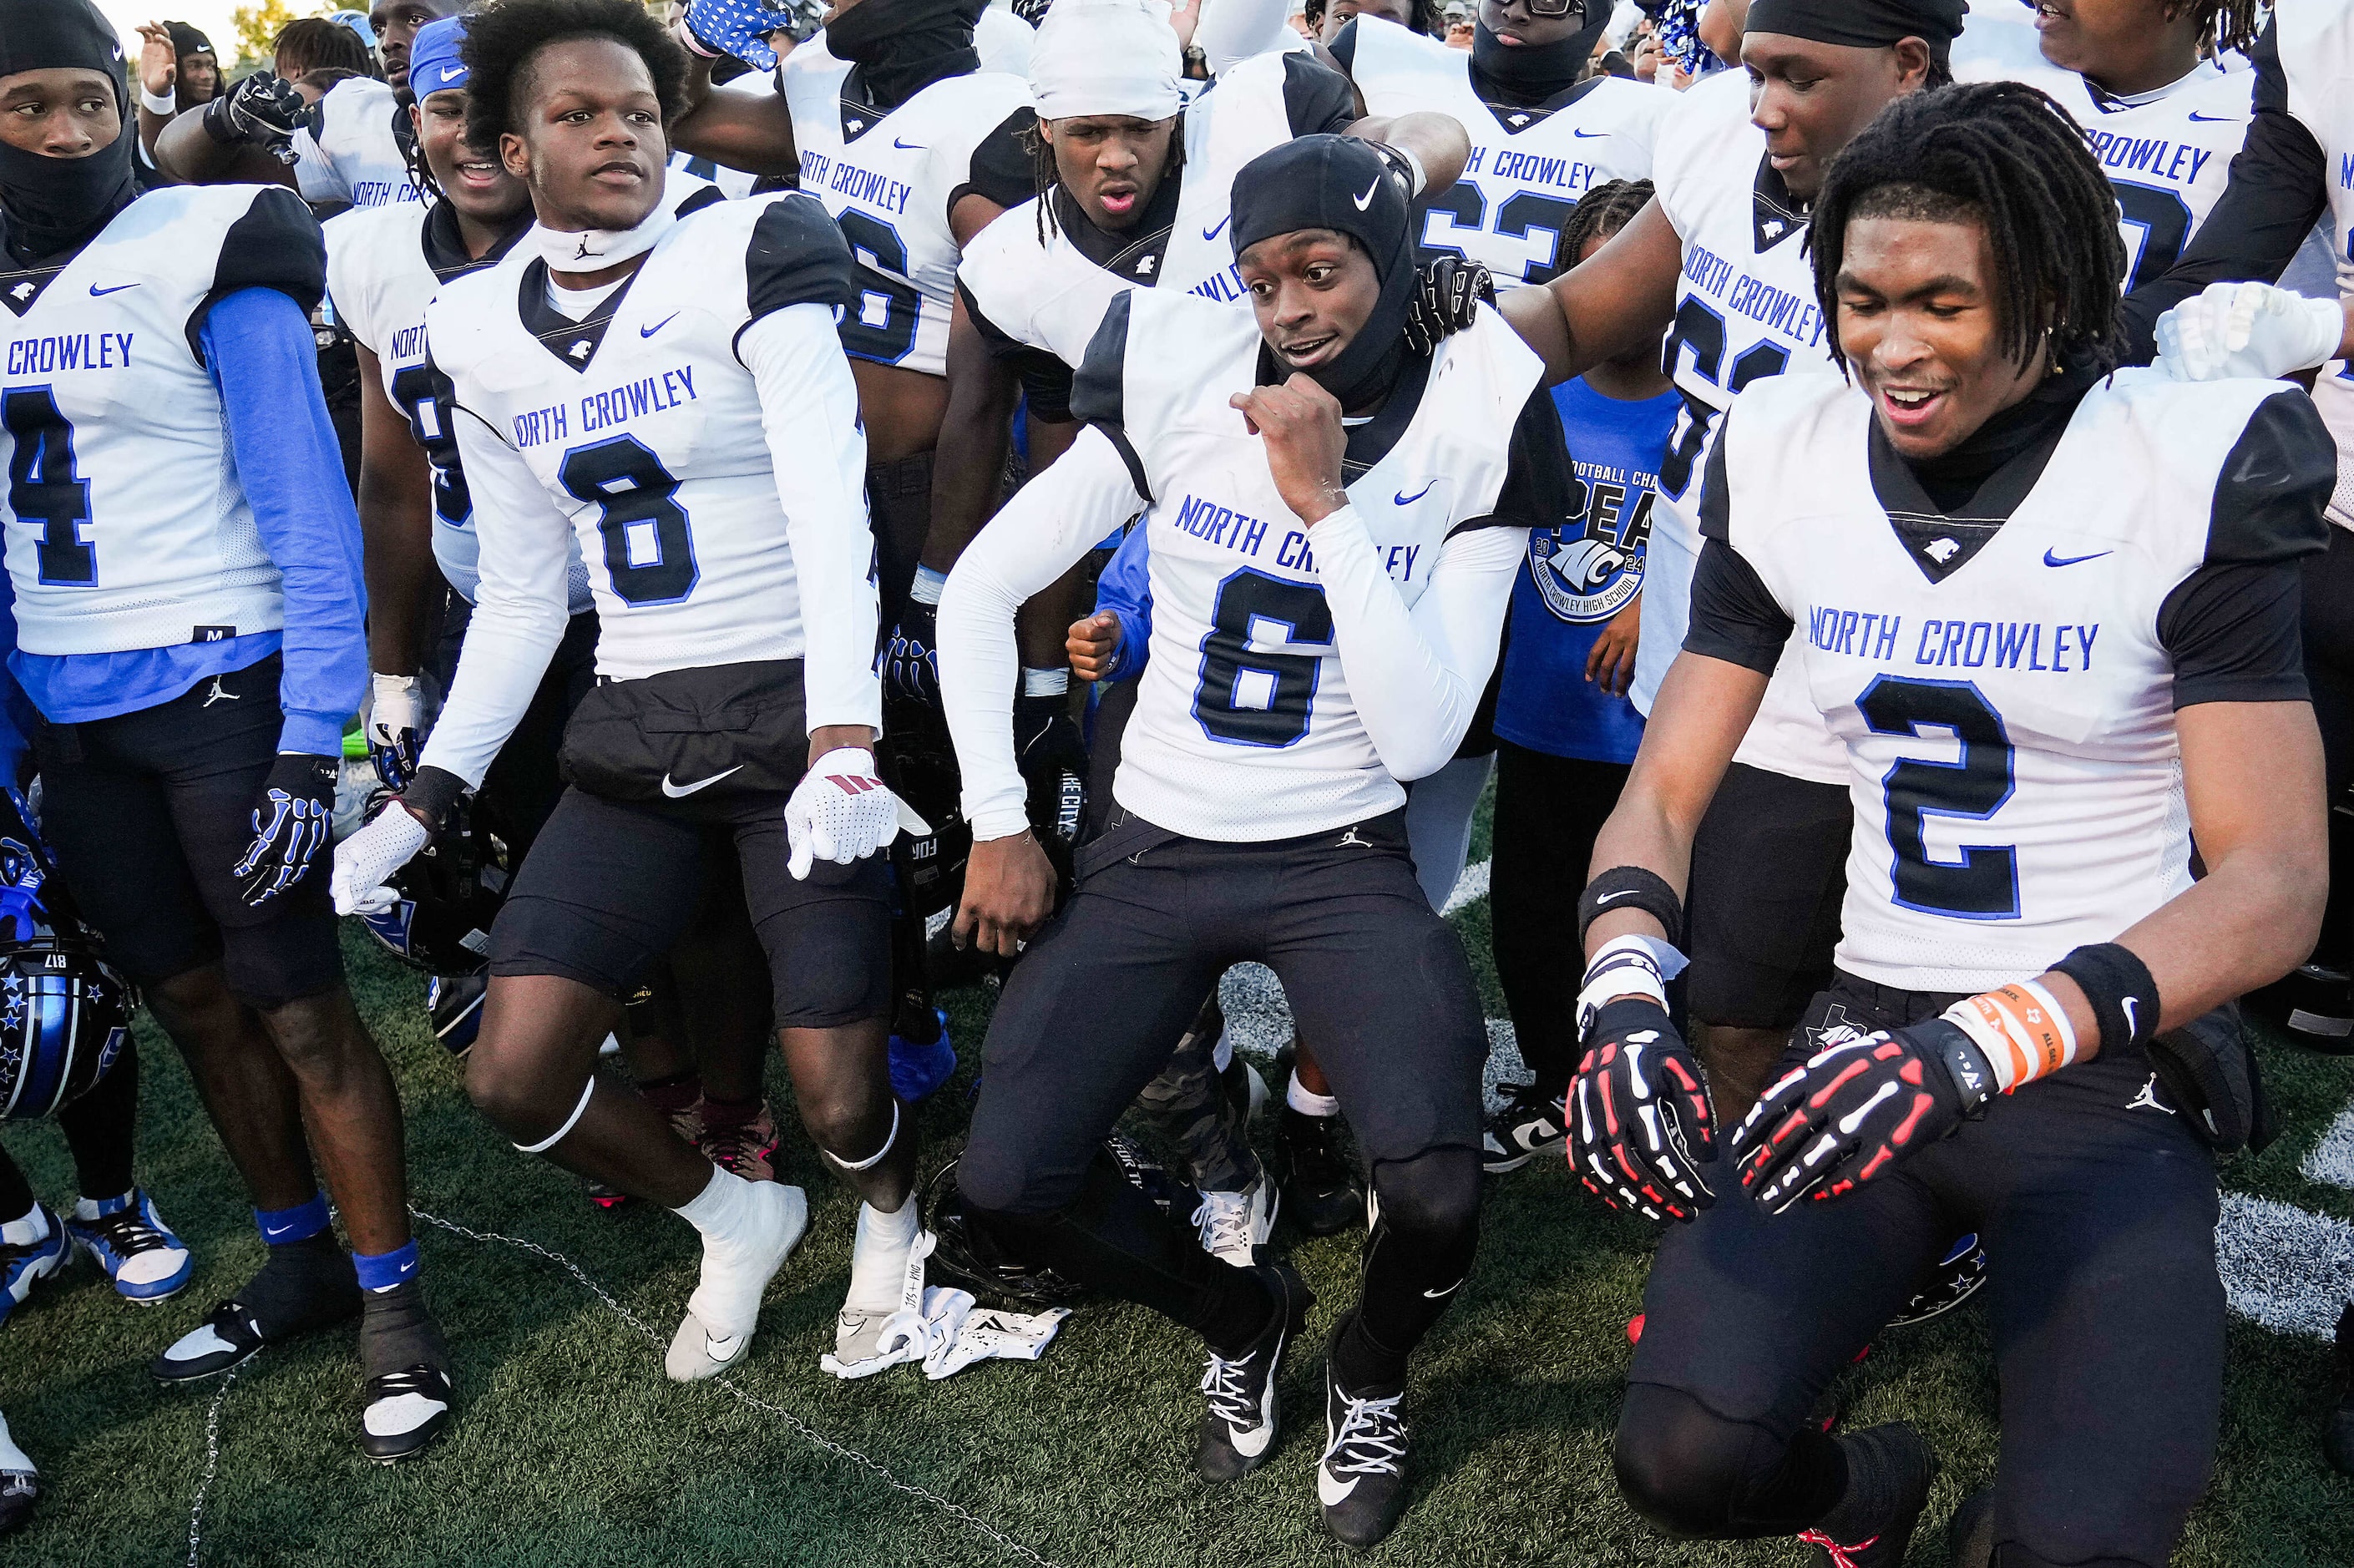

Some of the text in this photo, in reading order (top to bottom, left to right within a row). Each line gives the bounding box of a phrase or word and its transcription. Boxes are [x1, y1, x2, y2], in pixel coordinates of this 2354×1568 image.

[799, 149, 912, 215] ORTH CROWLEY
[1493, 150, 1595, 191] CROWLEY
[1728, 274, 1827, 348] CROWLEY
[8, 332, 134, 375] CROWLEY
[390, 324, 428, 361] NORT
[581, 365, 697, 432] CROWLEY
[0, 382, 99, 588] 4
[1572, 461, 1659, 488] OTBALL CHA
[557, 432, 701, 609] 8
[1174, 494, 1420, 583] NORTH CREY
[1537, 560, 1636, 613] NORTH CROWLEY HIGH SCHOOL
[1626, 554, 1644, 574] 24
[206, 630, 223, 642] M
[1190, 564, 1335, 749] 6
[1810, 604, 2099, 672] NORTH CROWLEY
[1057, 795, 1081, 827] CITY
[1855, 672, 2022, 919] 2
[912, 837, 937, 860] FOR
[44, 953, 67, 969] 817
[1111, 1143, 1143, 1190] FOR TH
